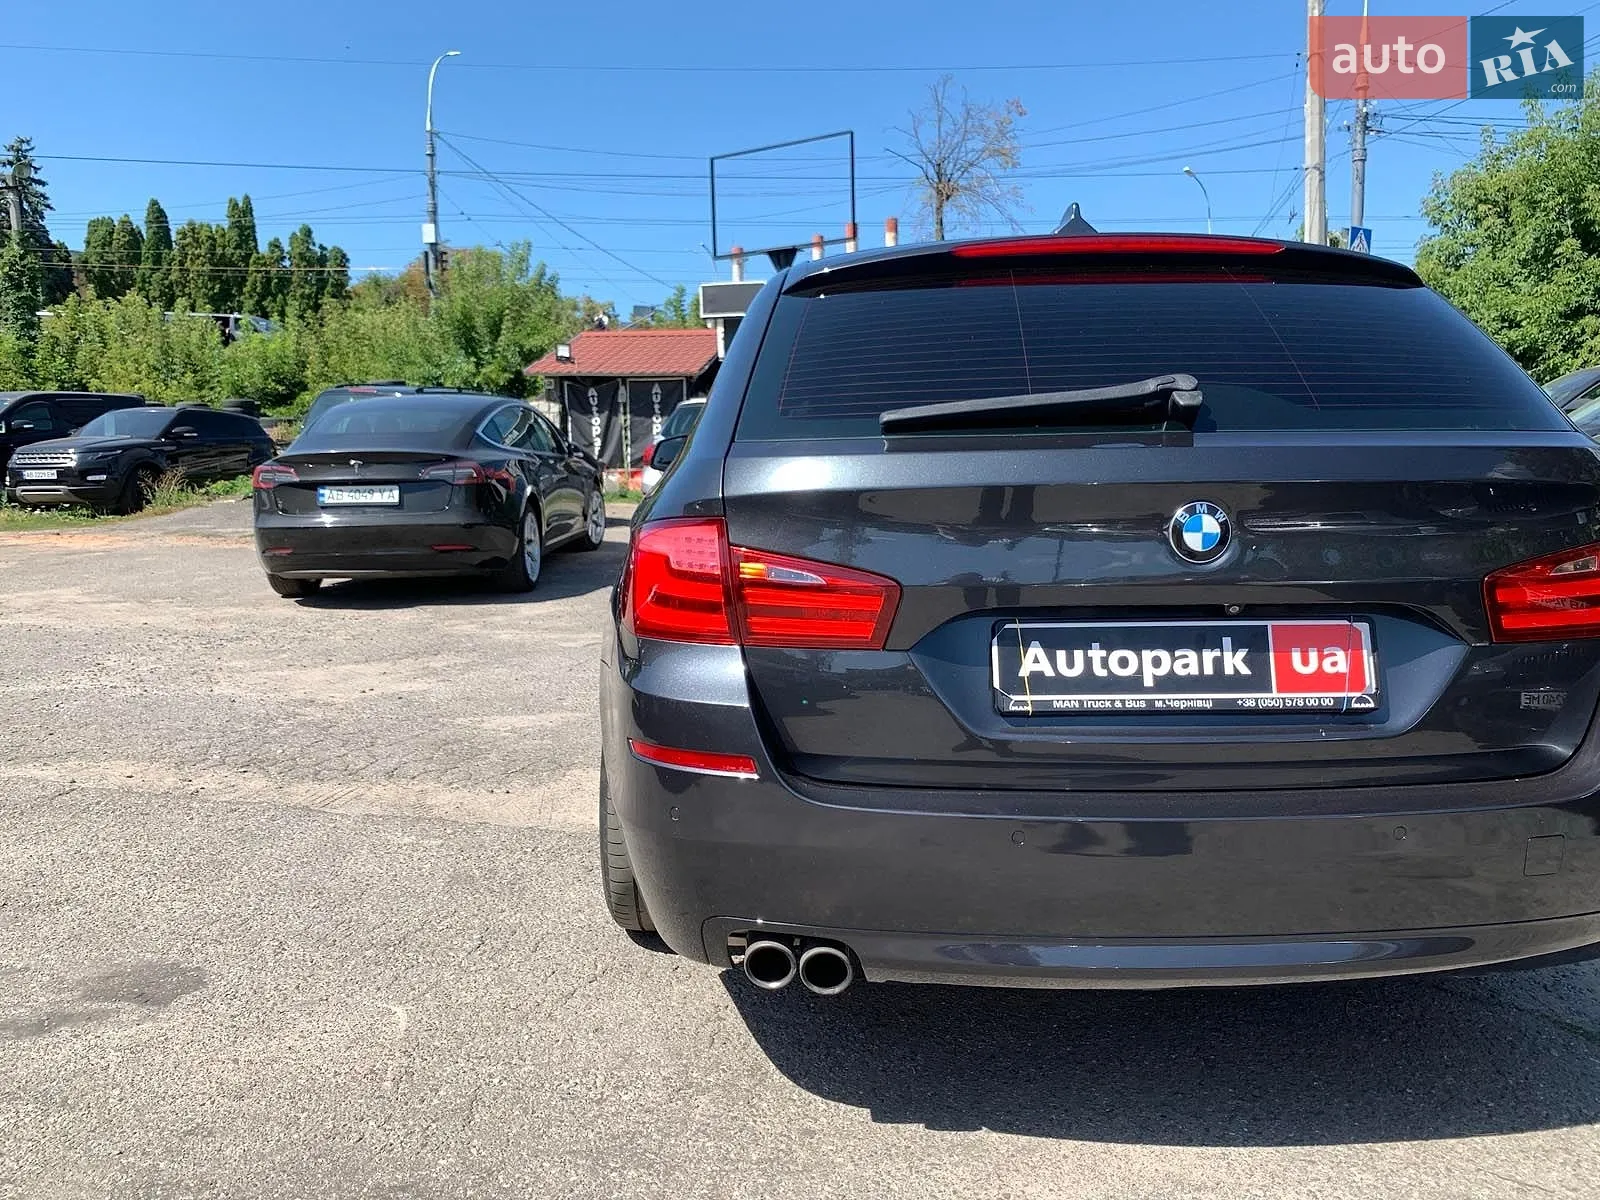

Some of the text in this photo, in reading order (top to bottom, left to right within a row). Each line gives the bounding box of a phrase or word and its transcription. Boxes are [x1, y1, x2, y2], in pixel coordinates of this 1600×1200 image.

[587, 387, 602, 460] Autopar
[1176, 503, 1227, 523] BMW
[1018, 637, 1347, 687] Autopark ua
[1053, 699, 1147, 709] MAN Truck & Bus
[1236, 697, 1335, 709] +38 (050) 578 00 00
